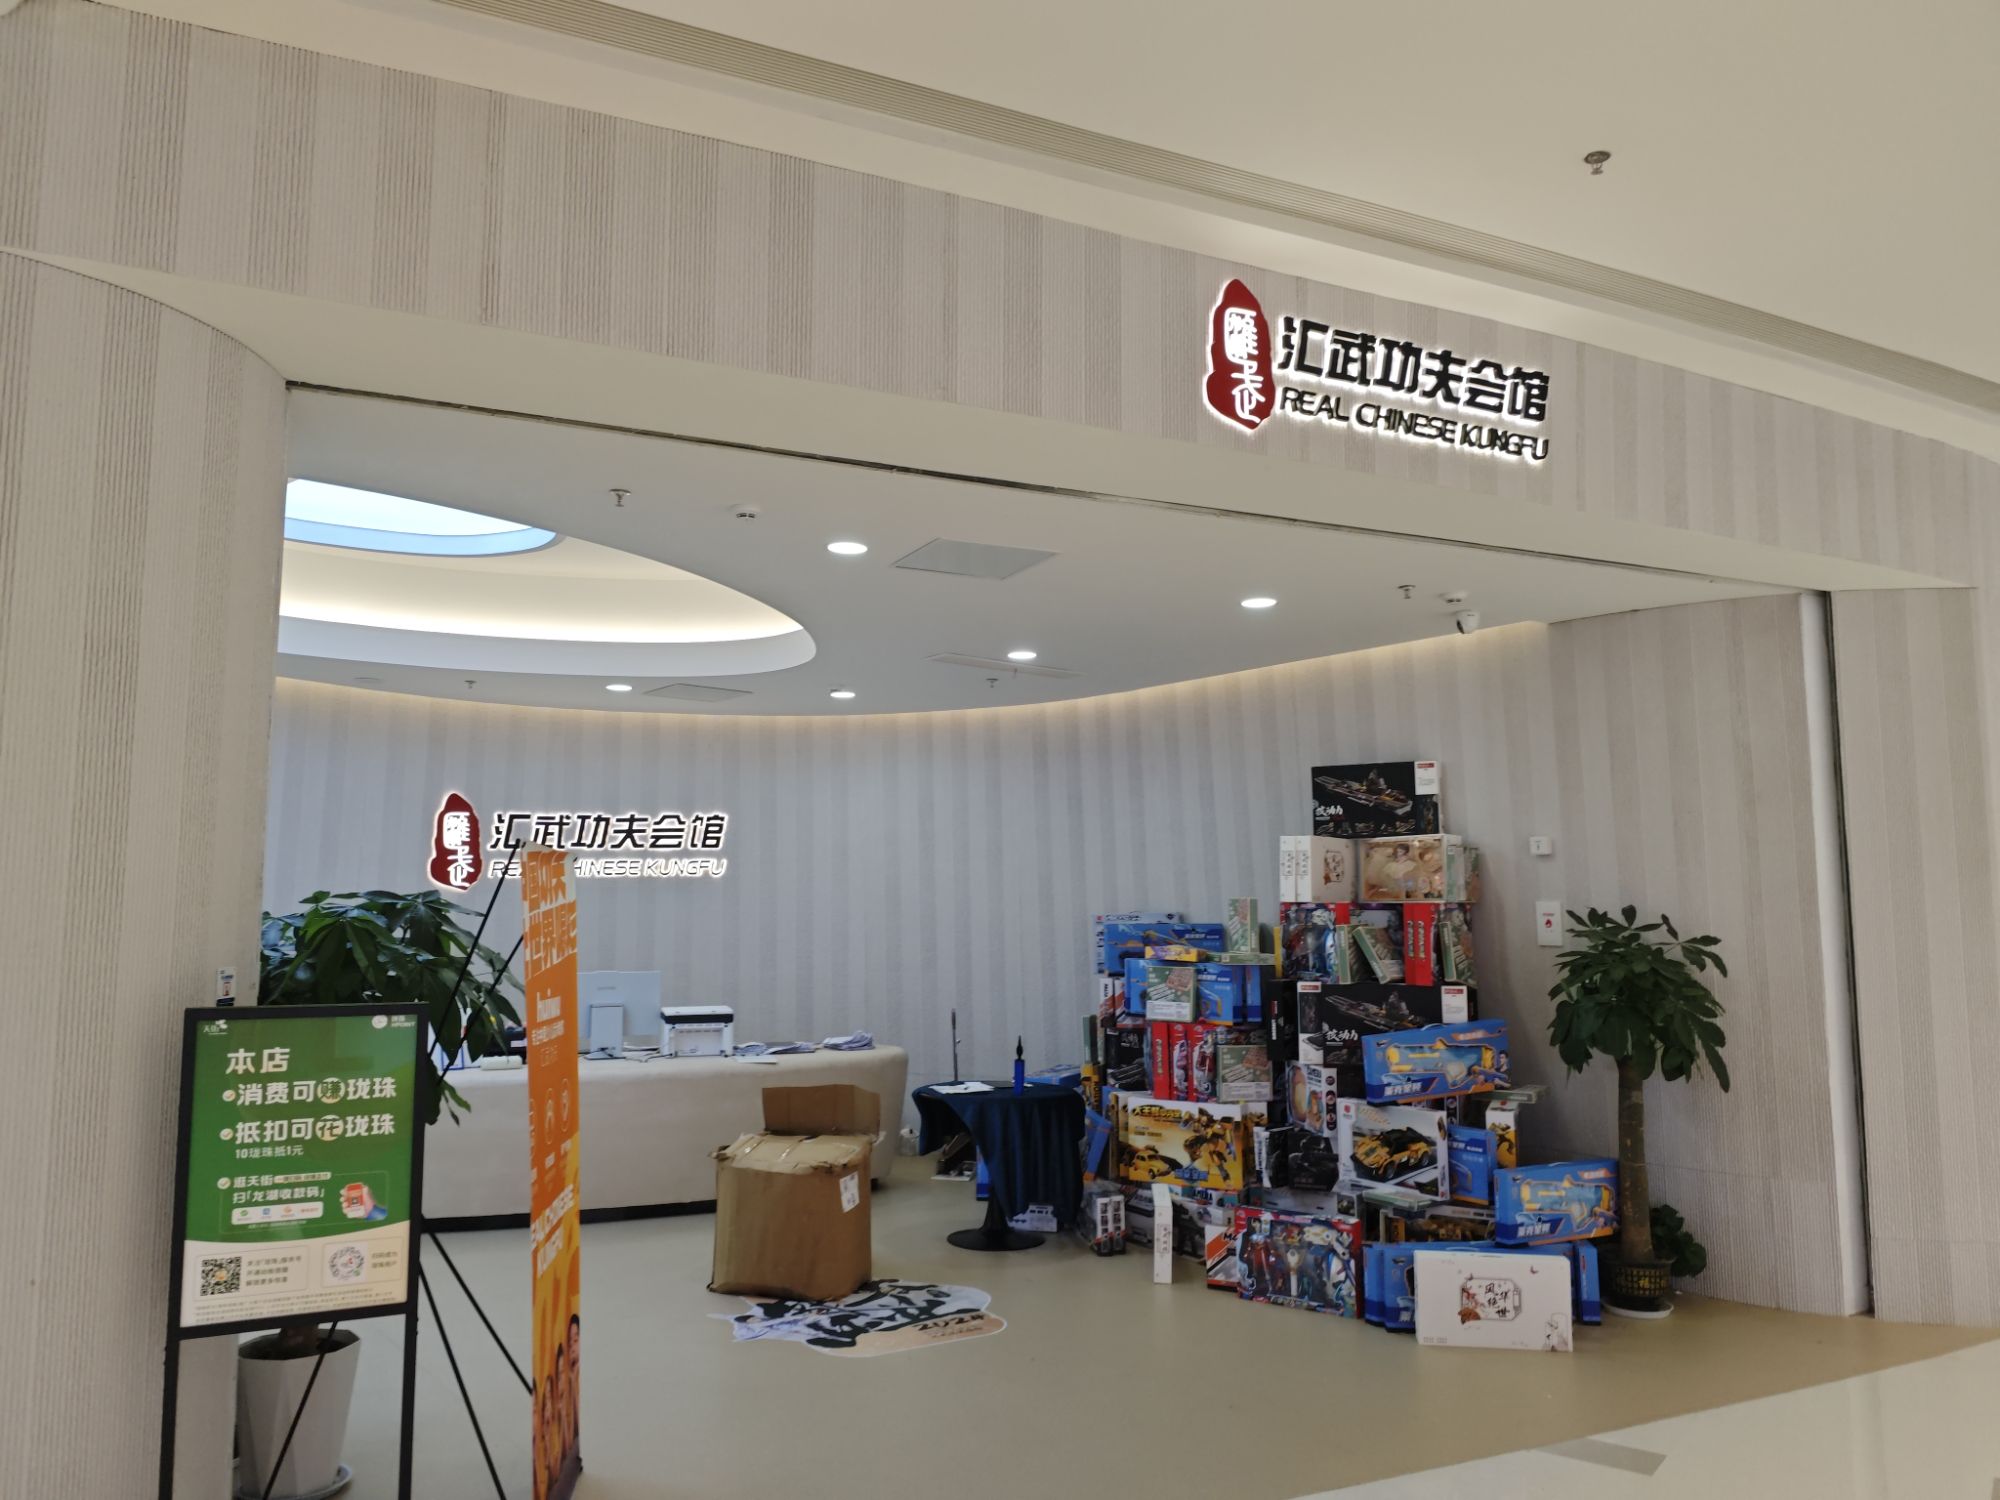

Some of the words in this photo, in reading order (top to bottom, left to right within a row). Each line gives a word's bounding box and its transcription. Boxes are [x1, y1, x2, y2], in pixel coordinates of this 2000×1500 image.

[1278, 316, 1549, 421] 汇武功夫会馆
[1280, 387, 1349, 422] REAL
[1356, 403, 1457, 443] CHINESE
[1460, 423, 1549, 460] KUNGFU
[489, 813, 728, 849] 汇武功夫会馆
[575, 860, 640, 877] HINESE
[645, 860, 726, 877] KUNGFU
[225, 1047, 290, 1075] 本店
